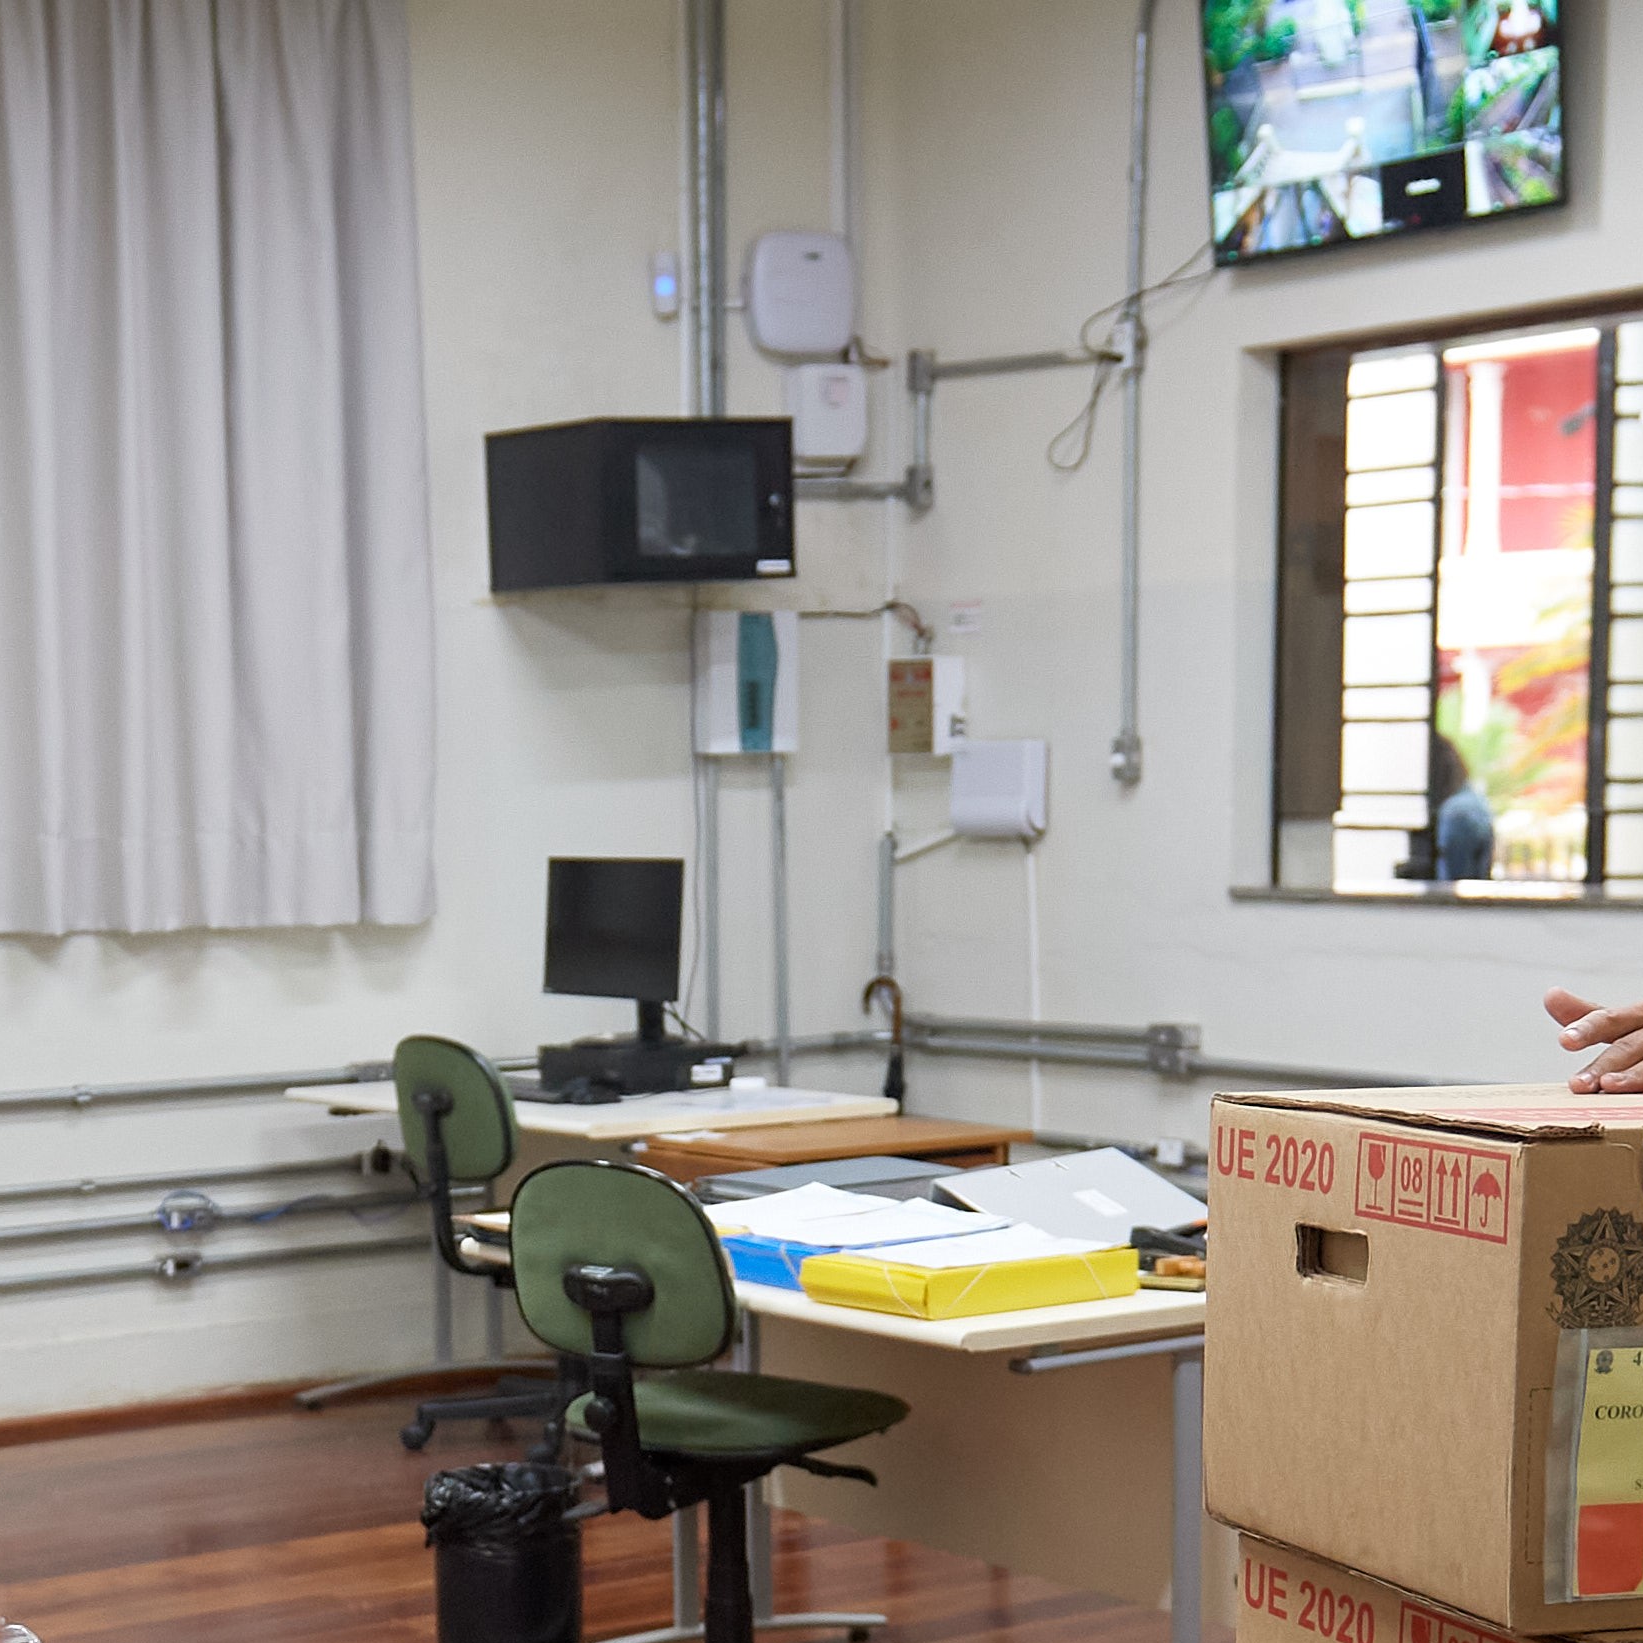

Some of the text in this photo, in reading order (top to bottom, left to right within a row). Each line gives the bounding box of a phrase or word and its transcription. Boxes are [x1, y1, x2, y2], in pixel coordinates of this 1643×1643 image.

[1216, 1125, 1335, 1195] UE 2020
[1400, 1155, 1423, 1194] 08
[1245, 1557, 1288, 1621] UE
